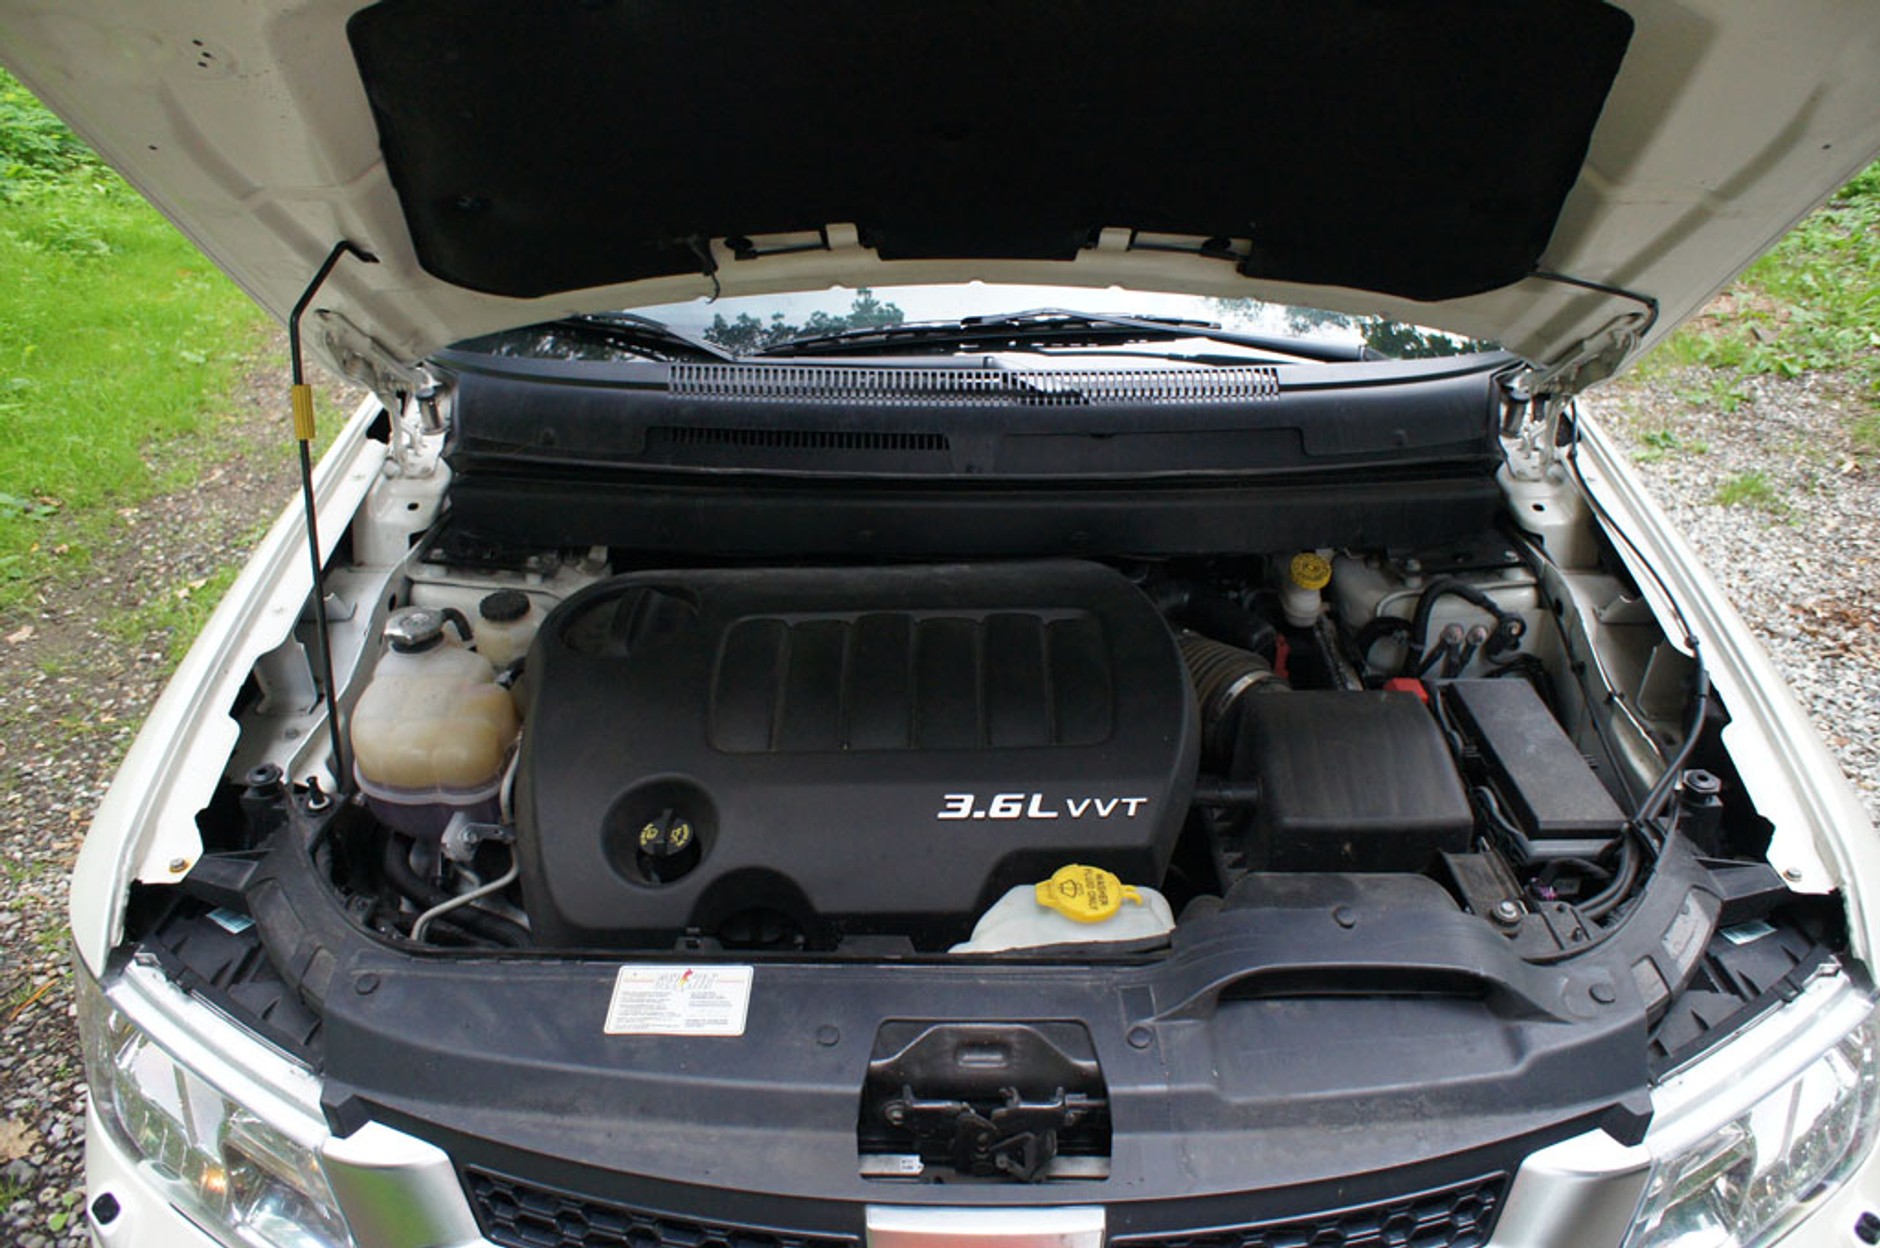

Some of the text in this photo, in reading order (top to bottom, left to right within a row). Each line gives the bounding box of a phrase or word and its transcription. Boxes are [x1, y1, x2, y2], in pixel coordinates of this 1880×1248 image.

[938, 793, 1147, 819] 3.6L VVT
[1087, 890, 1099, 911] ONLY
[1096, 873, 1108, 906] WASHER
